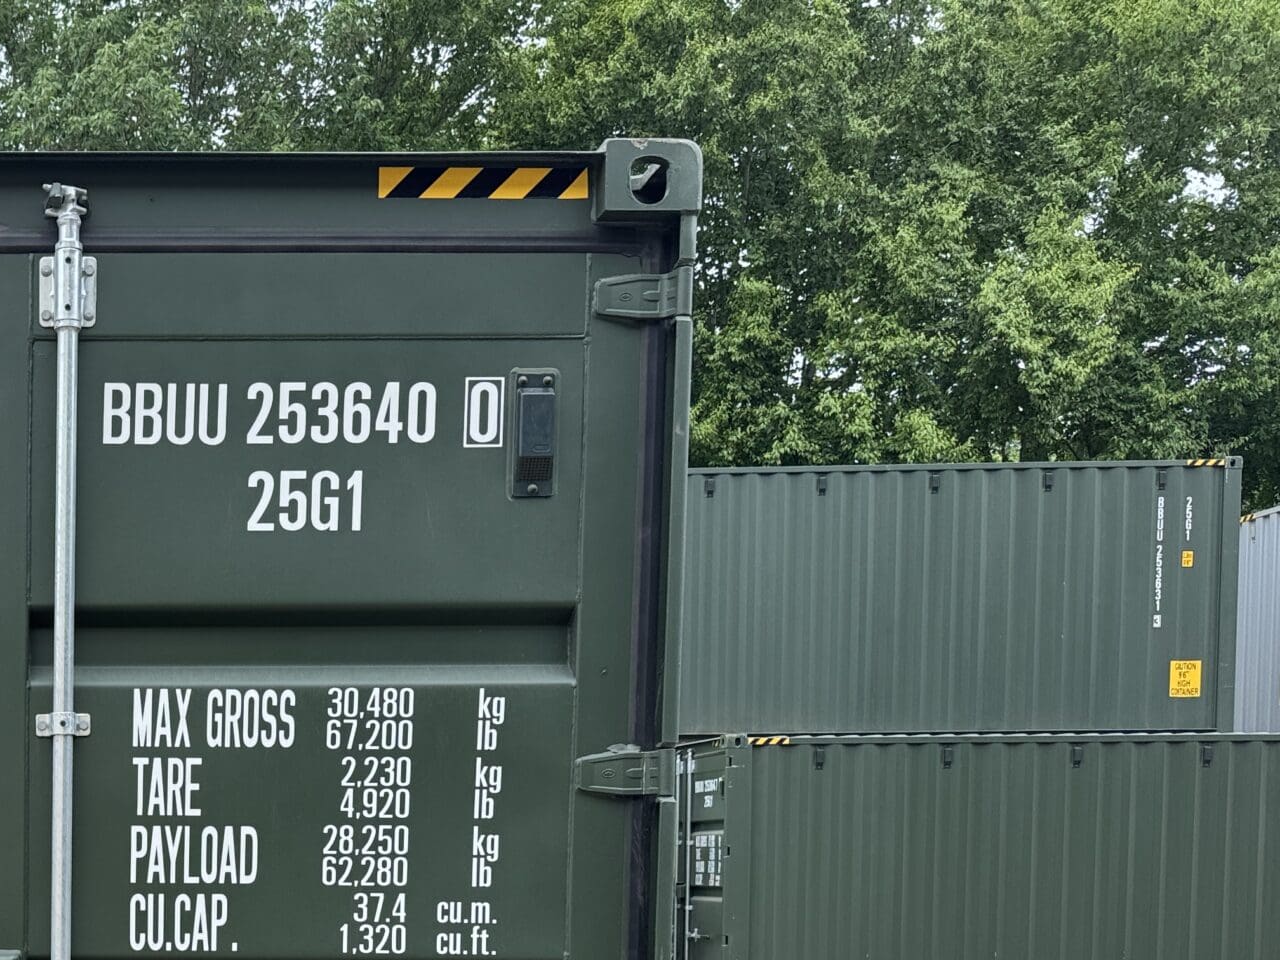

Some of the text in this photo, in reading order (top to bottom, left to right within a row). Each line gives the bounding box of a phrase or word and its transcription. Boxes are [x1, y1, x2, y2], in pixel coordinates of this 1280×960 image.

[103, 380, 500, 445] BBUU 253640 0
[246, 470, 363, 532] 25G1
[1156, 496, 1165, 542] BBUU
[132, 687, 506, 748] MAX GROSS 30,480 kg
[326, 719, 498, 751] 67,200 lb
[132, 756, 503, 816] TARE 2,230 kg
[339, 788, 495, 820] 4,920 lb
[130, 824, 500, 885] PAYLOAD 28,250 kg
[321, 857, 493, 888] 62,280 lb
[353, 893, 407, 923] 37.4
[436, 901, 498, 924] cu.m.
[339, 924, 497, 956] 1,320 cu.ft.
